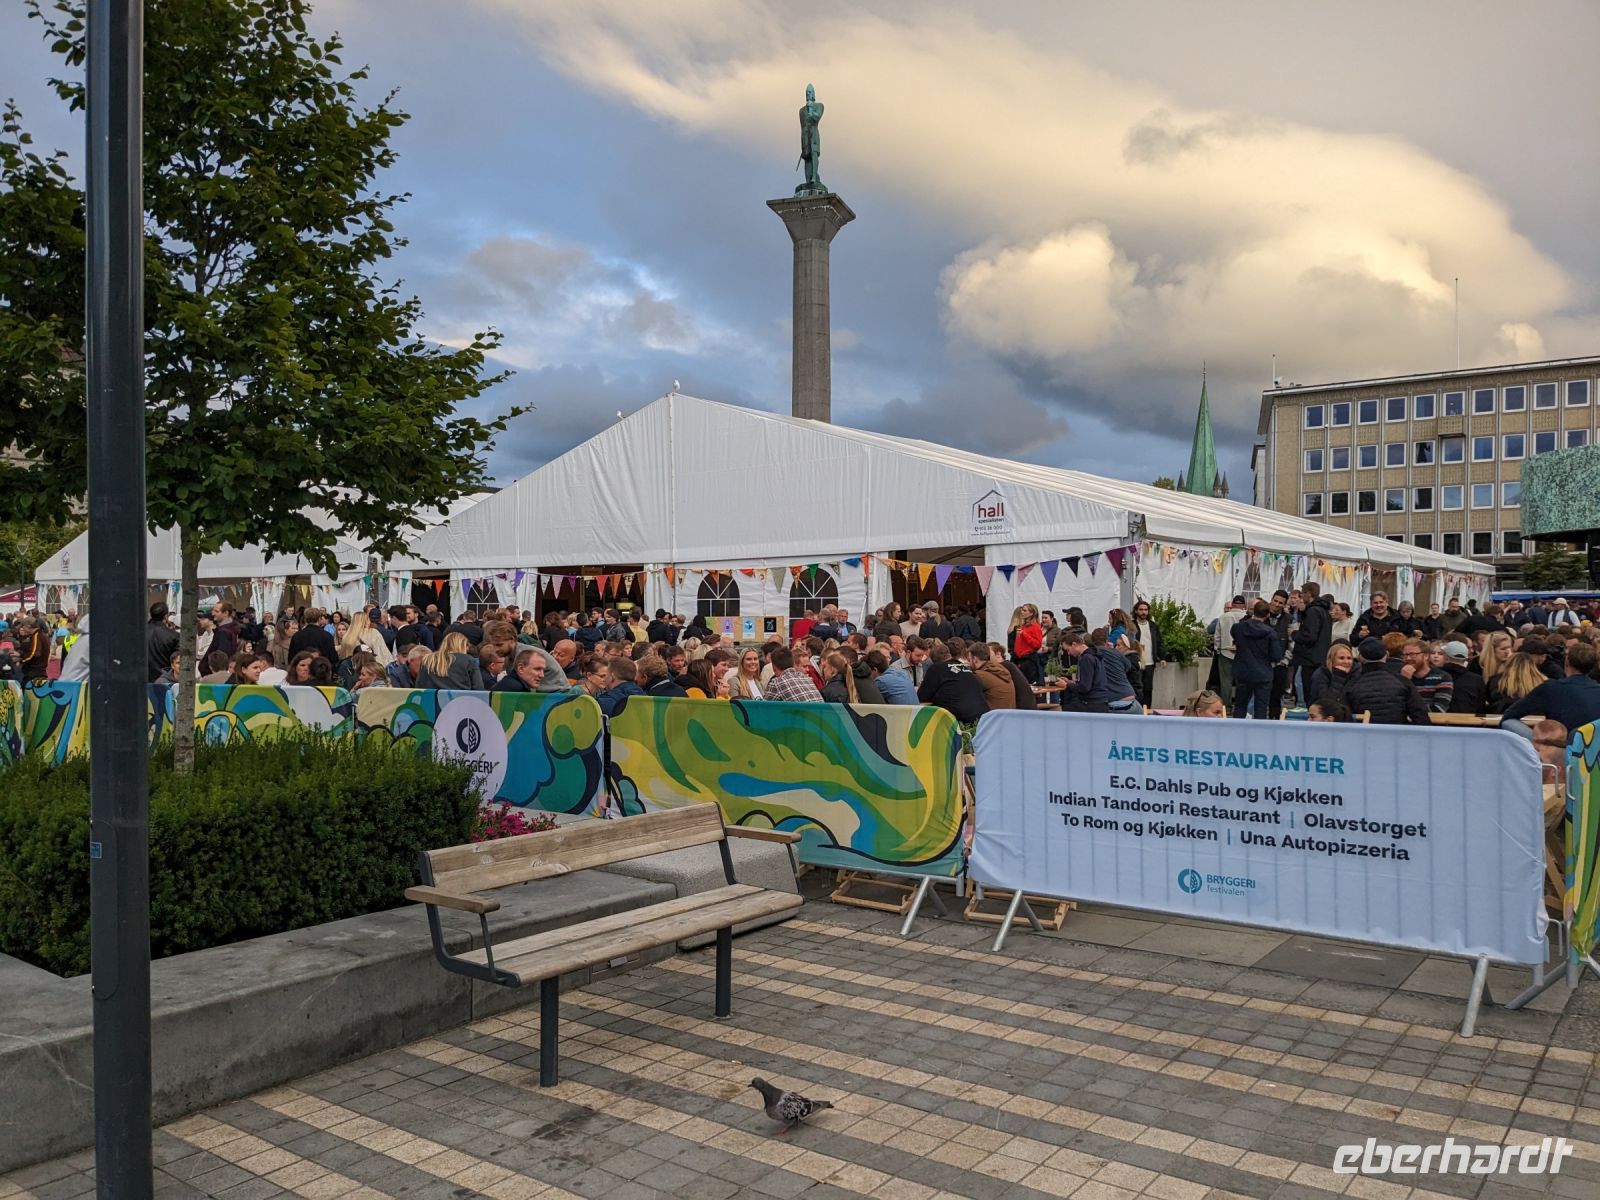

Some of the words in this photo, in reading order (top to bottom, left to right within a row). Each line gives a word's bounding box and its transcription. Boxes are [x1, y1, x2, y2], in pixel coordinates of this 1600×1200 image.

[978, 502, 1004, 518] hall
[1108, 740, 1169, 763] ÅRETS
[1175, 749, 1344, 775] RESTAURANTER
[1110, 775, 1140, 790] E.C.
[1145, 778, 1192, 794] Dahls
[1197, 782, 1231, 797] Pub
[1236, 787, 1259, 803] og
[1264, 786, 1343, 806] Kjøkken
[1049, 791, 1097, 807] Indian
[1101, 796, 1174, 814] Tandoori
[1179, 803, 1280, 824] Restaurant
[1304, 813, 1427, 839] Olavstorget
[1061, 813, 1079, 827] To
[1083, 815, 1119, 831] Rom
[1123, 821, 1144, 837] og
[1148, 821, 1218, 841] Kjøkken
[1240, 830, 1276, 847] Una
[1281, 834, 1410, 861] Autopizzeria
[1206, 874, 1256, 889] BRYGGERI
[1207, 885, 1245, 896] festivalen
